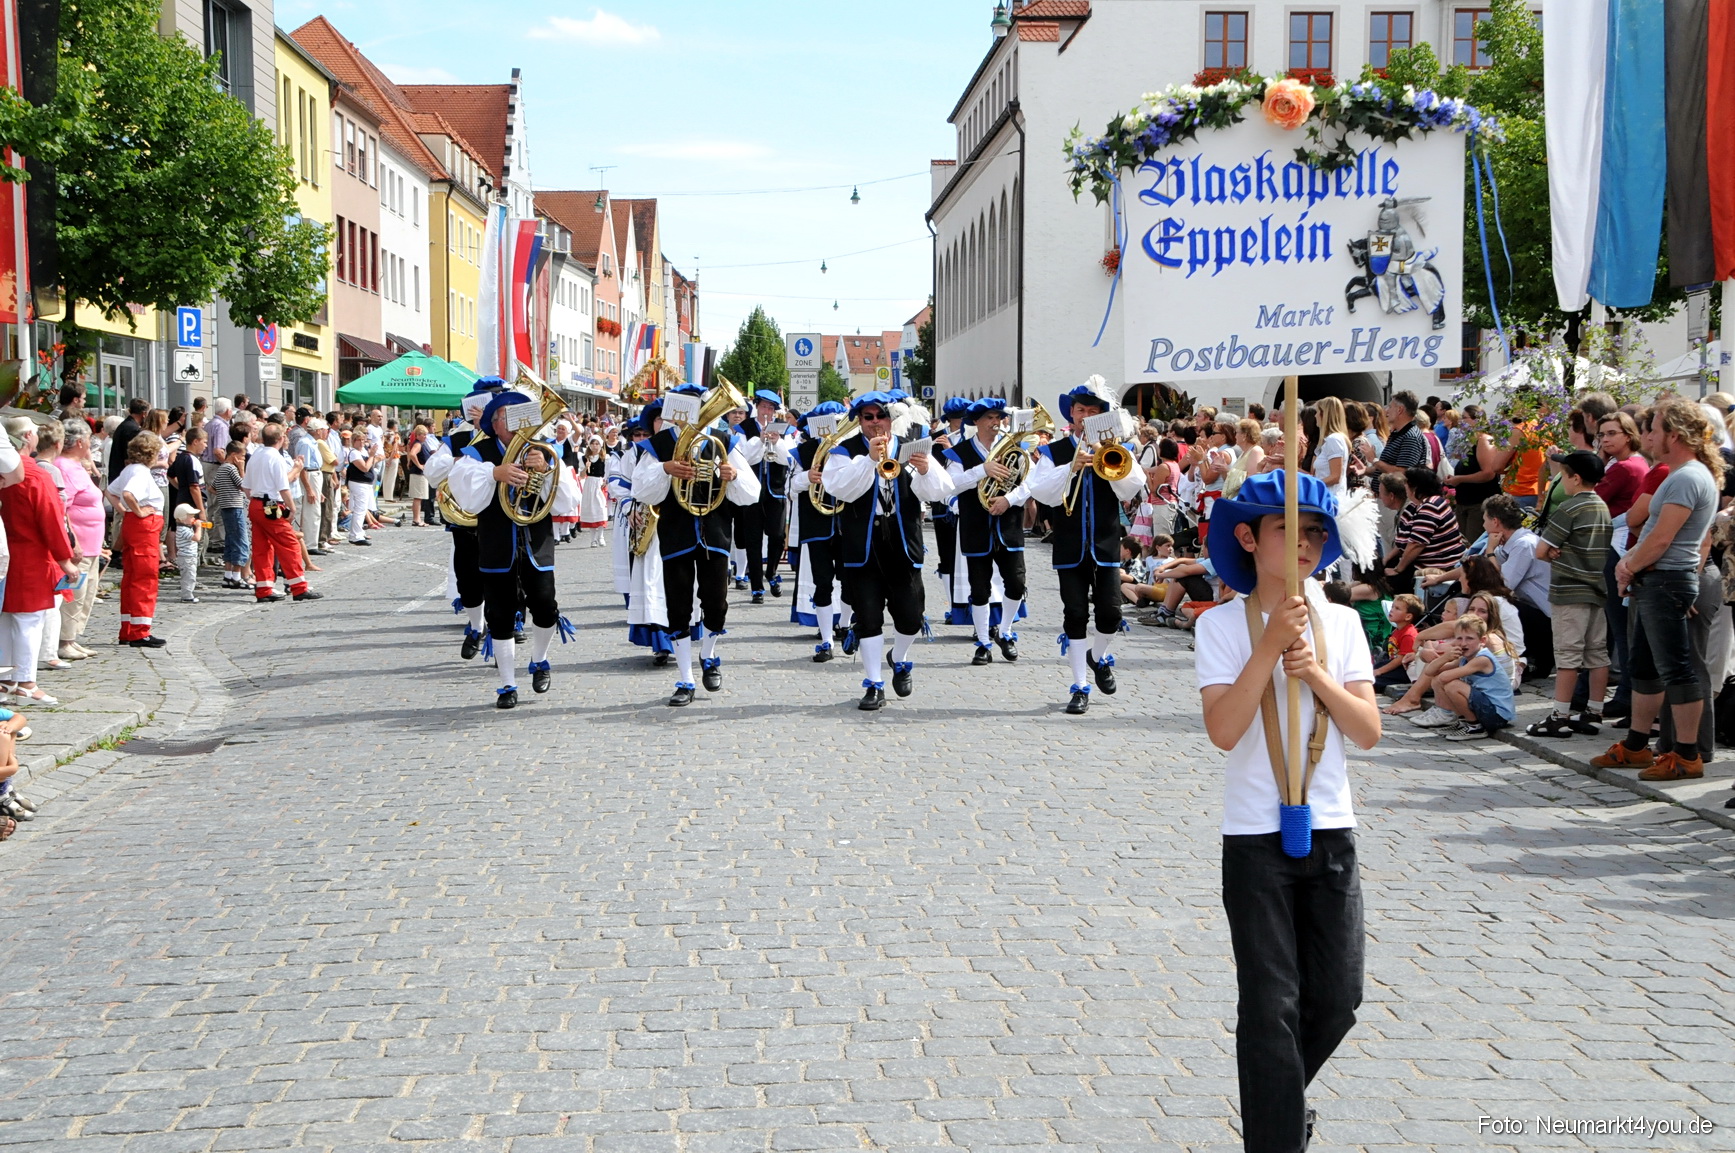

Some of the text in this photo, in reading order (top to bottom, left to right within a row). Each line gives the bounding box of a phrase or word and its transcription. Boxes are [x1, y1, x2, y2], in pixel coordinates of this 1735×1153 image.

[1138, 146, 1400, 208] Blaskapelle
[1141, 211, 1333, 279] Eppelein
[183, 312, 197, 342] P
[1255, 302, 1334, 329] Markt
[1143, 327, 1443, 373] Postbauer-Heng
